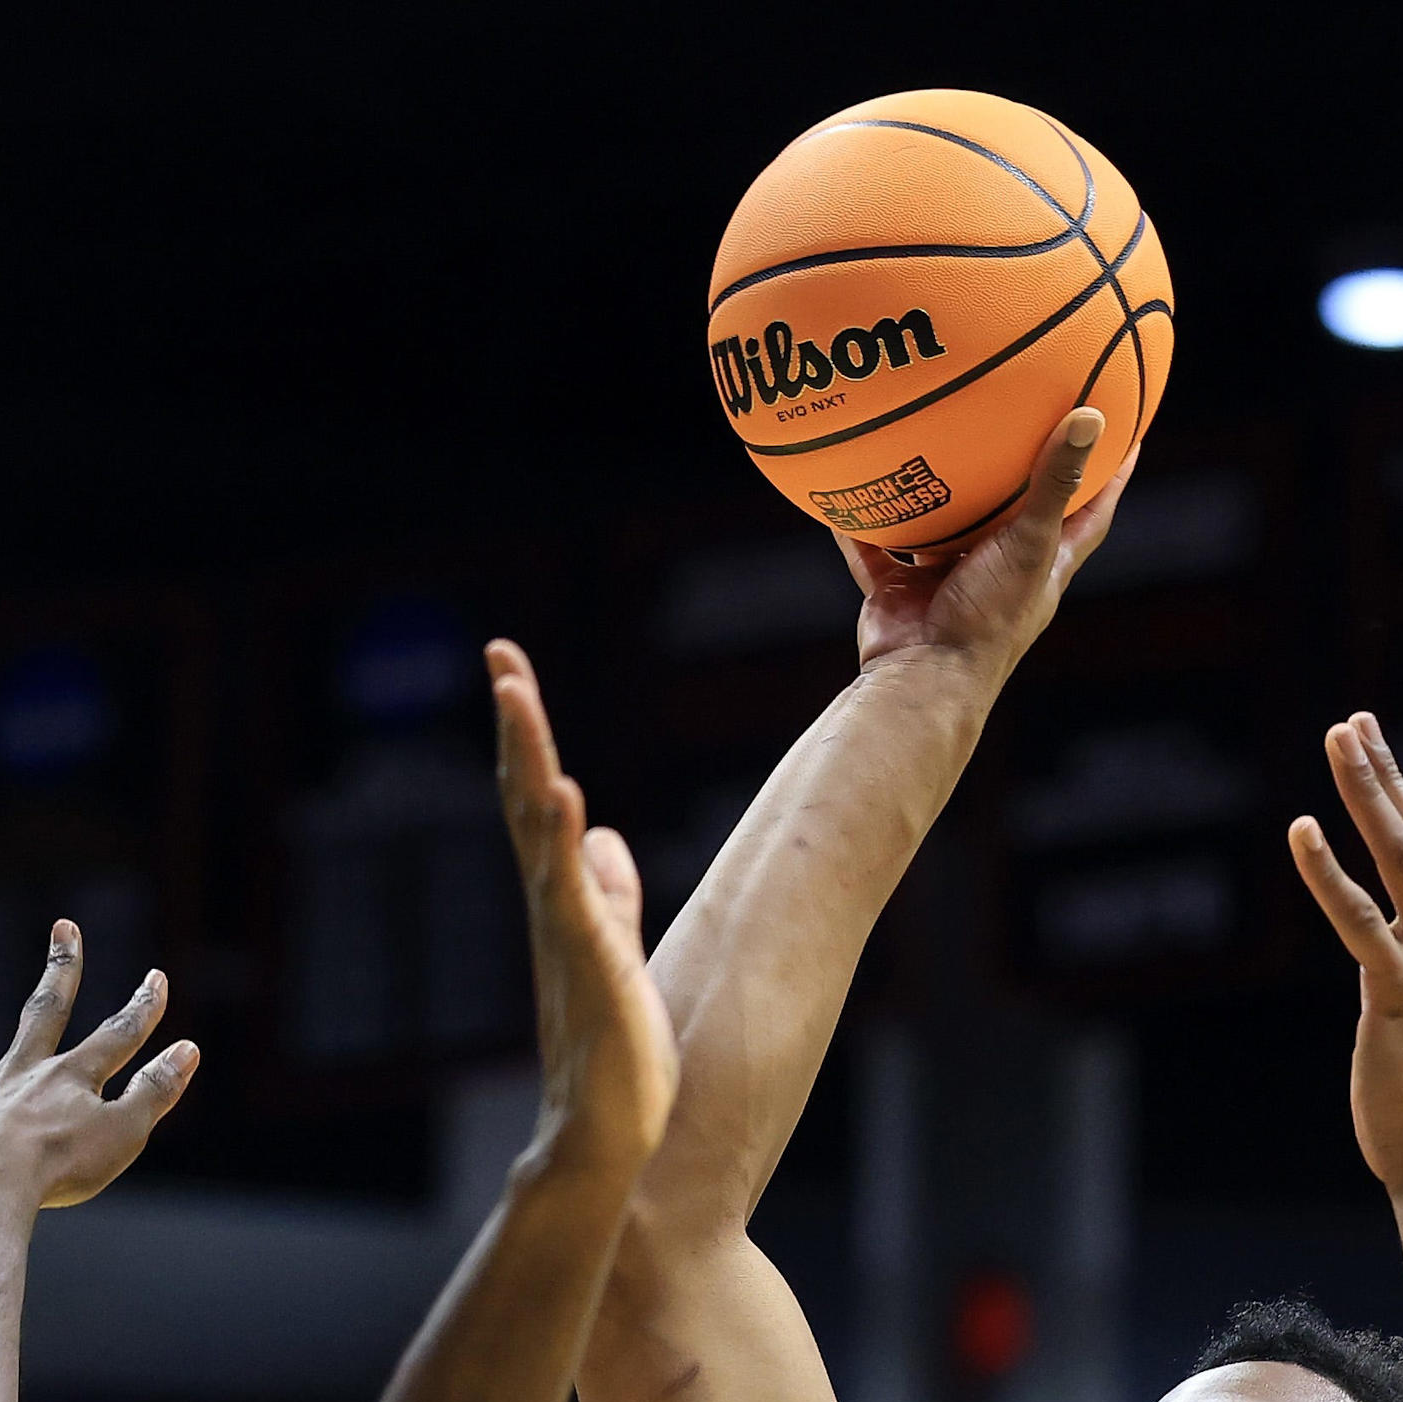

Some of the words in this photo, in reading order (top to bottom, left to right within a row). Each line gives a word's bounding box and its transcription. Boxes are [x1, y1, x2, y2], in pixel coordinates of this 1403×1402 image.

[711, 308, 947, 418] Wilson
[776, 405, 807, 422] EVO
[810, 393, 846, 412] NXT
[829, 479, 898, 511] MARCH
[851, 479, 948, 524] MADNESS
